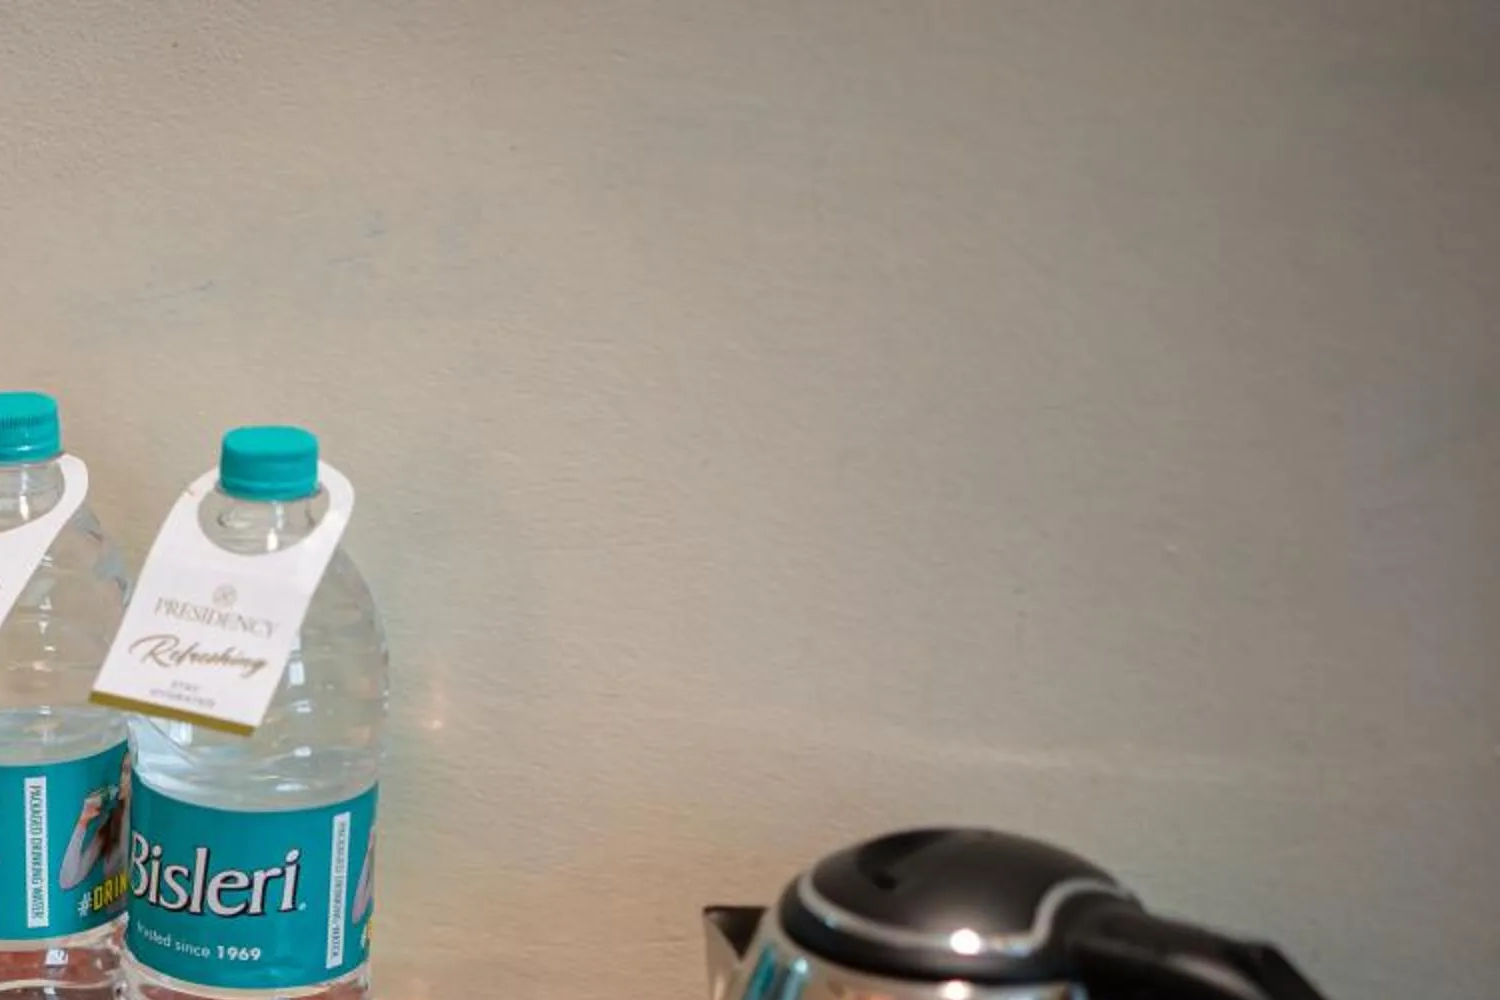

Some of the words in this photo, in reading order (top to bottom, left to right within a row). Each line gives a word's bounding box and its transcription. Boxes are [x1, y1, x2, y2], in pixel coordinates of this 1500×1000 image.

[154, 597, 278, 639] PRESIDENCY
[128, 634, 267, 679] Refreshing
[175, 940, 211, 958] since
[216, 945, 261, 961] 1969
